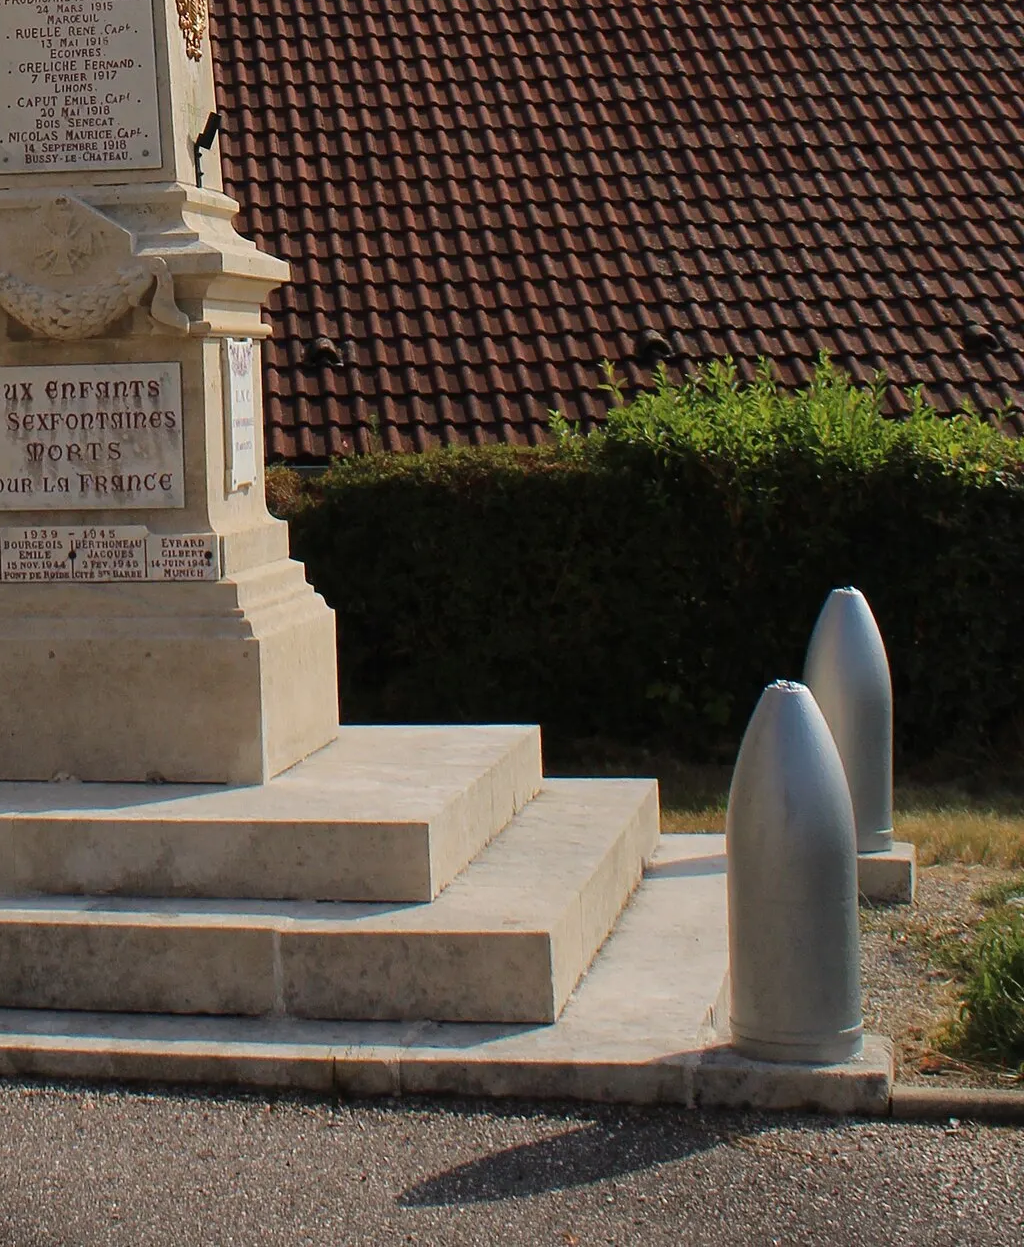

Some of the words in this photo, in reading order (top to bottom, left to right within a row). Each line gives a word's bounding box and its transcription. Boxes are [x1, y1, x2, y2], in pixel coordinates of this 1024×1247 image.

[36, 6, 48, 14] 24
[57, 4, 83, 13] MARS
[91, 2, 113, 10] 1915
[16, 27, 61, 39] RUELLE
[69, 26, 96, 36] RENE
[41, 39, 52, 48] 13
[60, 38, 78, 47] MAI
[32, 75, 38, 83] 7
[45, 73, 87, 83] FEVRIER
[94, 71, 117, 80] 1917
[18, 96, 58, 108] CAPUT
[41, 108, 54, 117] 20
[61, 106, 79, 117] MAI
[87, 106, 110, 115] 1918
[36, 119, 60, 129] BOIS
[9, 132, 58, 142] NICOLAS
[25, 144, 35, 153] 14
[42, 142, 97, 152] SEPTEMBRE
[104, 140, 126, 150] 1918
[45, 380, 160, 400] ENFANTS
[27, 442, 121, 461] MORTS
[43, 477, 69, 492] LA
[76, 473, 172, 493] FRANCE
[24, 530, 57, 539] 1939
[83, 530, 115, 538] 1945
[4, 541, 63, 550] BOURGEOIS
[162, 539, 204, 548] EVRARD
[19, 551, 51, 559] EMILE
[88, 551, 133, 559] JACQUES
[162, 551, 204, 559] GILBERT
[188, 559, 211, 567] 1944
[113, 570, 142, 578] BARBE
[164, 570, 203, 578] MUNICH
